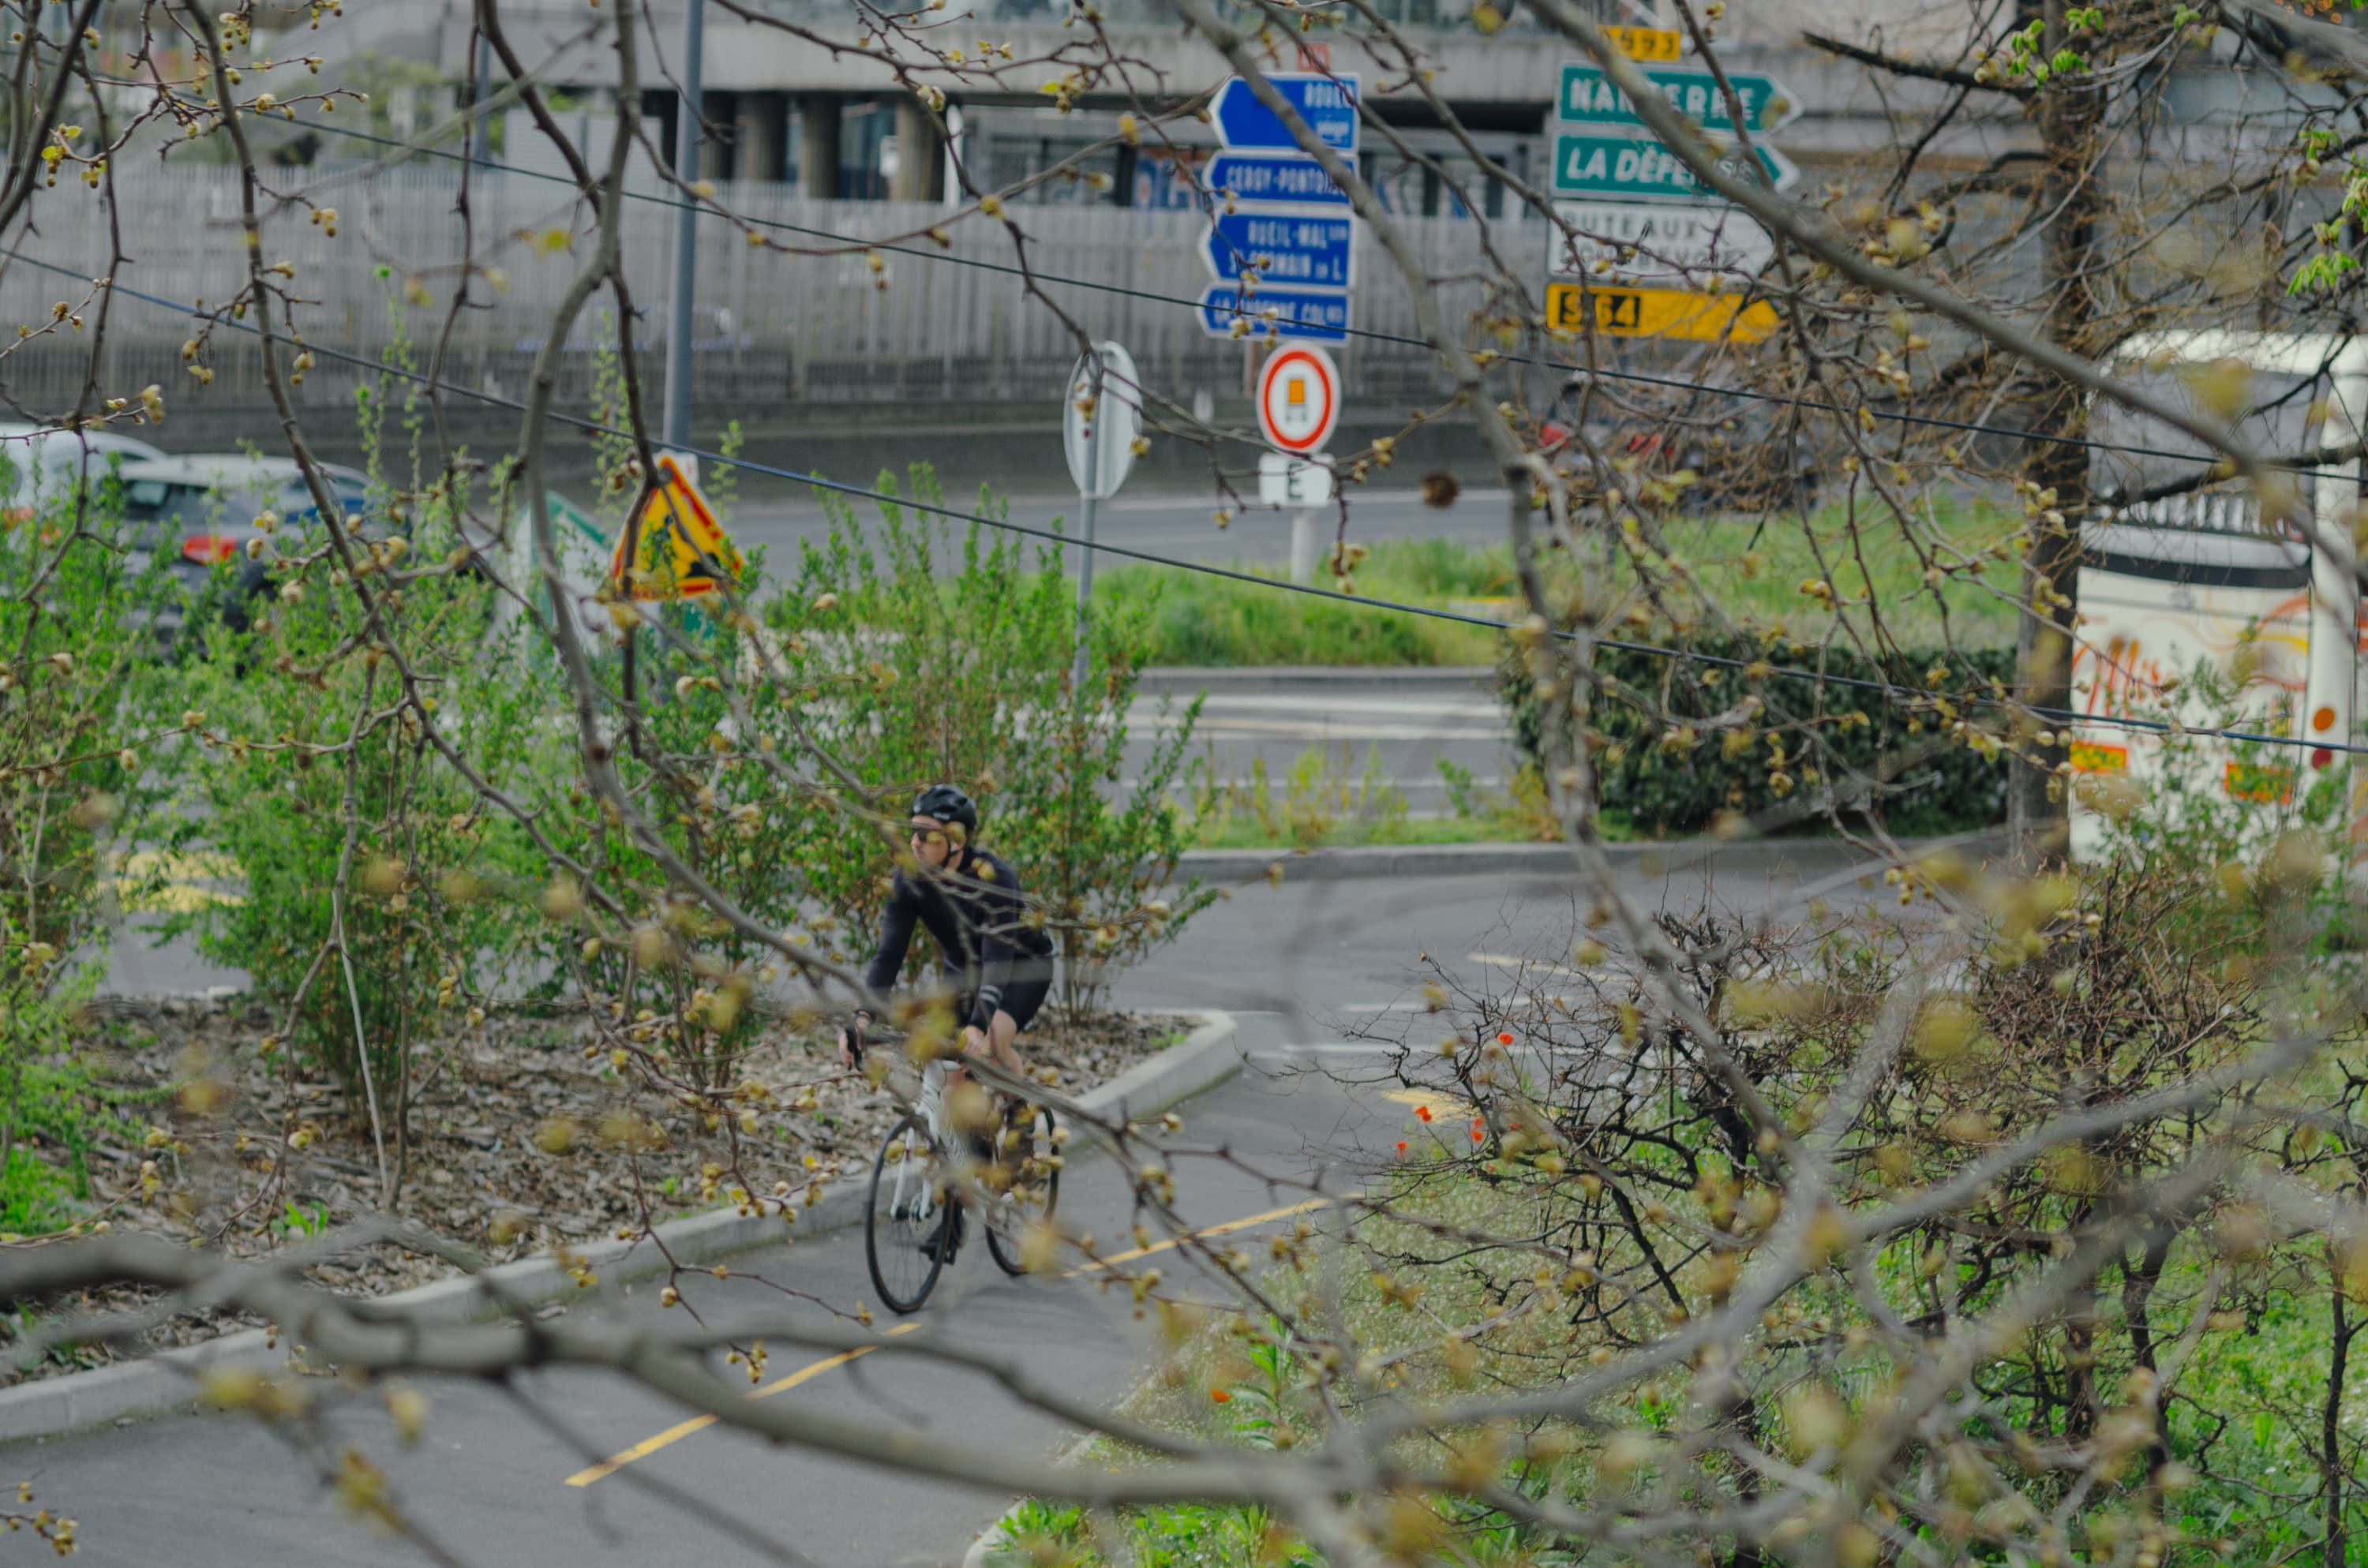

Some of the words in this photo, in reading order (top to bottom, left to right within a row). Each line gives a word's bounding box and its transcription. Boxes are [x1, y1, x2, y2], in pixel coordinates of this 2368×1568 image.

[1570, 77, 1754, 120] NANERRE
[1567, 147, 1606, 181] LA
[1614, 145, 1757, 188] DÉFESE
[1594, 294, 1637, 325] 64
